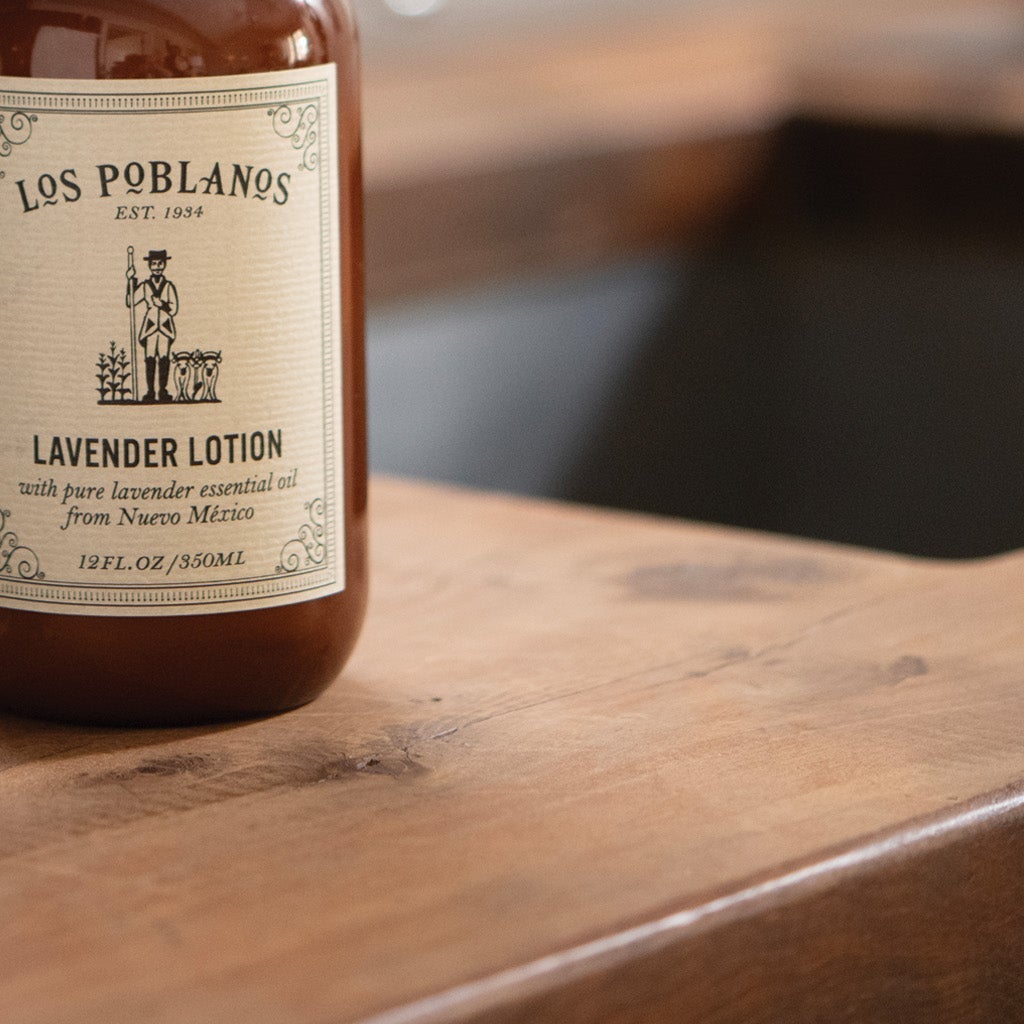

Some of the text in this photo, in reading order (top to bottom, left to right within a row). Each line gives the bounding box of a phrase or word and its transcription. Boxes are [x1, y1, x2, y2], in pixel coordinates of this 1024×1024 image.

[16, 160, 291, 213] LOS POBLANOS
[114, 205, 204, 220] EST. 1934
[33, 429, 282, 468] LAVENDER LOTION
[18, 469, 297, 505] with pure lavender essential oil
[60, 503, 254, 530] from Nuevo México
